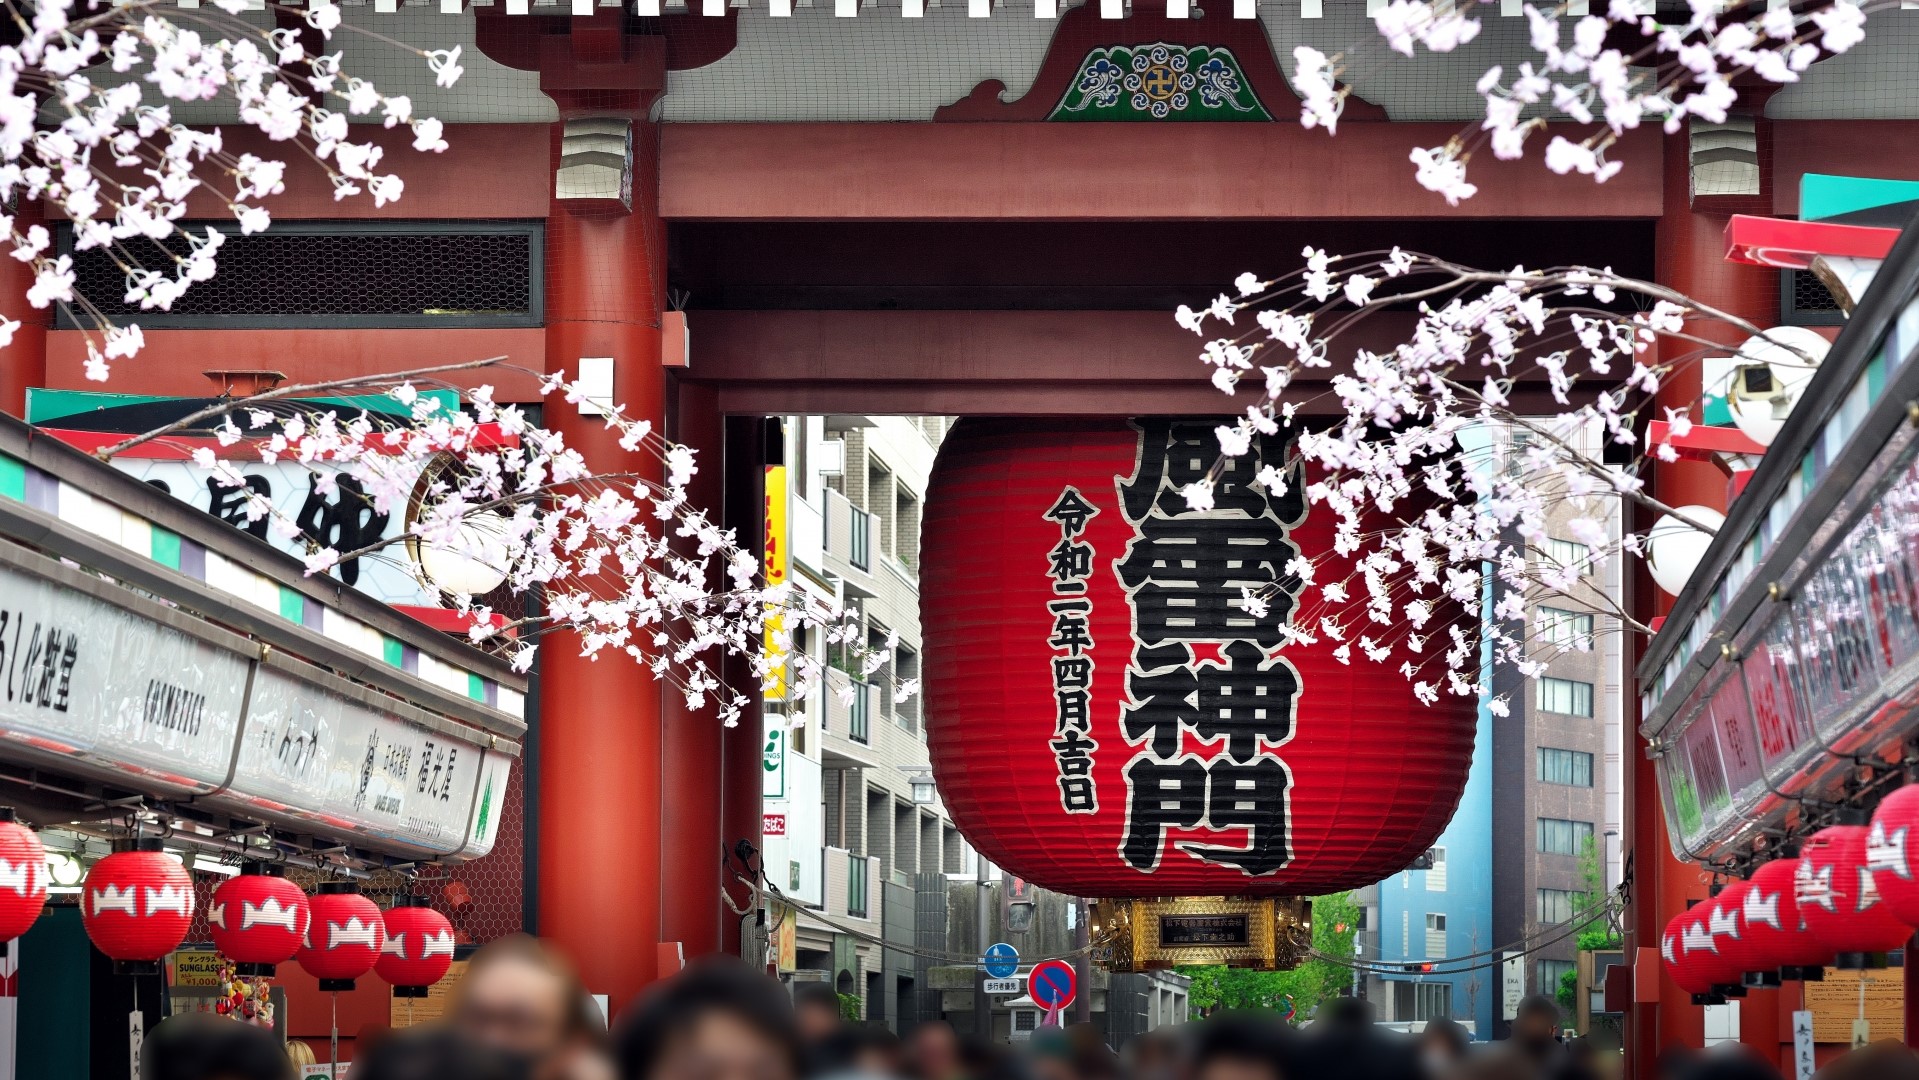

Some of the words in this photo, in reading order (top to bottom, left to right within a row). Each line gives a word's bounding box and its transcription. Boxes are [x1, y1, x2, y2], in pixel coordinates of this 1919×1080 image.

[1043, 486, 1100, 814] 令和二年四月吉日
[1114, 417, 1305, 877] 風雷神門
[143, 678, 206, 737] COSMETICS
[416, 740, 458, 803] 福光屋
[763, 816, 785, 833] たばこ
[987, 982, 1017, 991] 歩行者優先
